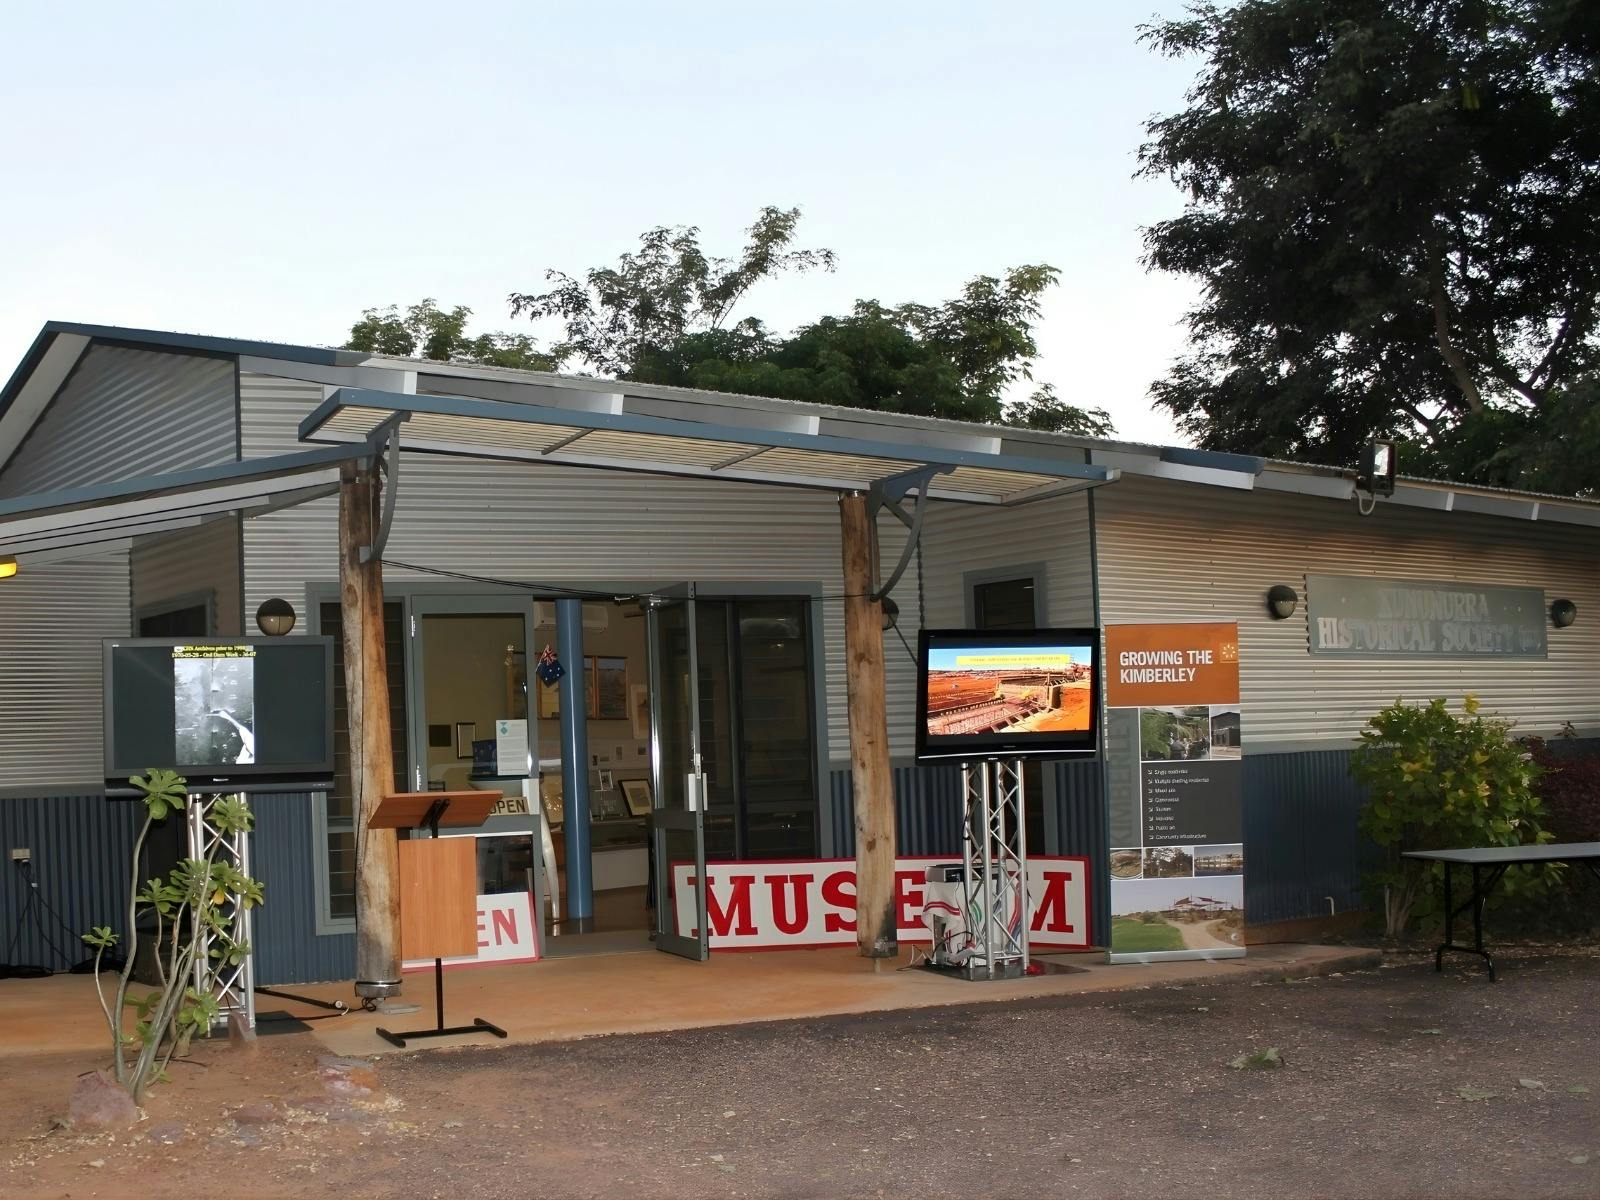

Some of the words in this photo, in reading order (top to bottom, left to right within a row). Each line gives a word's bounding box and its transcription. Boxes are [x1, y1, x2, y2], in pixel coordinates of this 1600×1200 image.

[1317, 617, 1435, 650] HISTORICAL
[1442, 621, 1514, 652] SOCIETY
[1120, 650, 1183, 666] GROWING
[1186, 650, 1213, 664] THE
[1120, 667, 1196, 683] KIMBERLEY
[687, 870, 1074, 936] MUSEM
